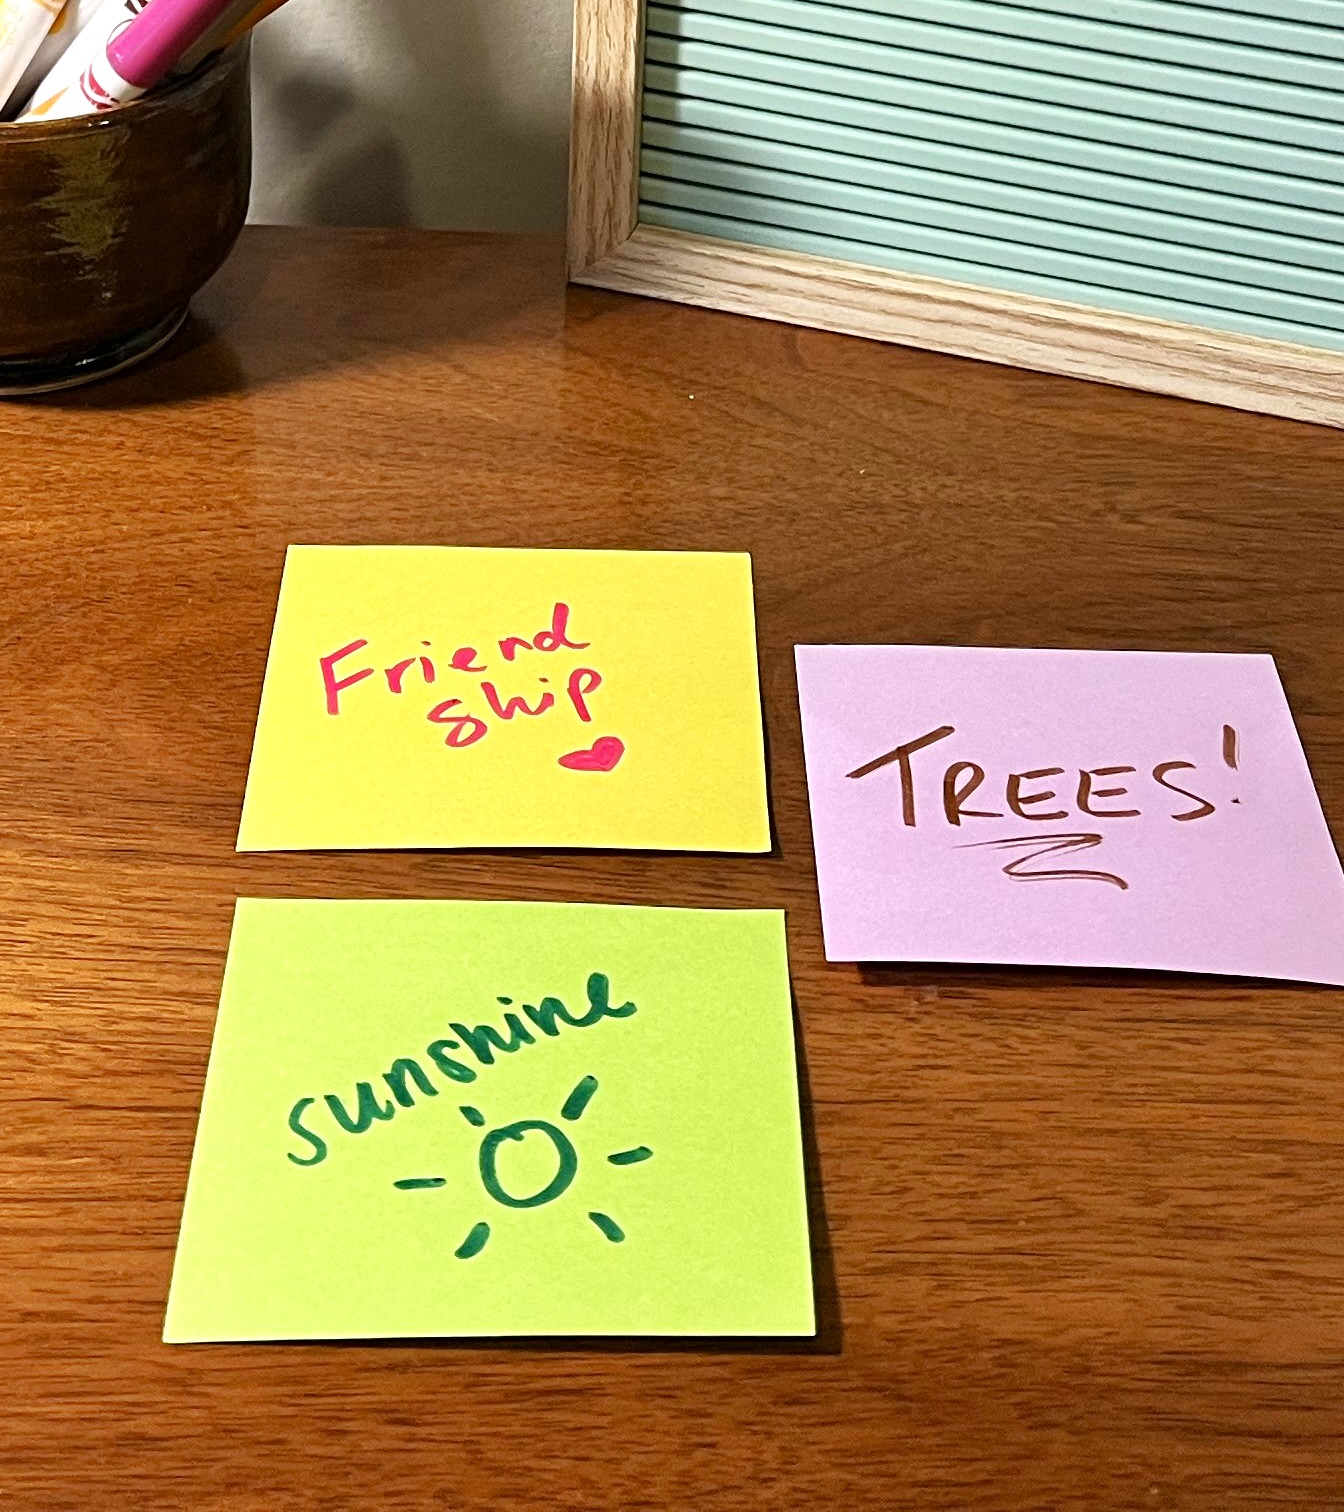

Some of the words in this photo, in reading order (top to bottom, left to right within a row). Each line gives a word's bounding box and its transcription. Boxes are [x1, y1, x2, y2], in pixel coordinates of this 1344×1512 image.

[318, 602, 592, 716] Friend
[428, 666, 604, 748] ship
[845, 724, 1245, 829] TREES!
[286, 971, 637, 1169] sunshine
